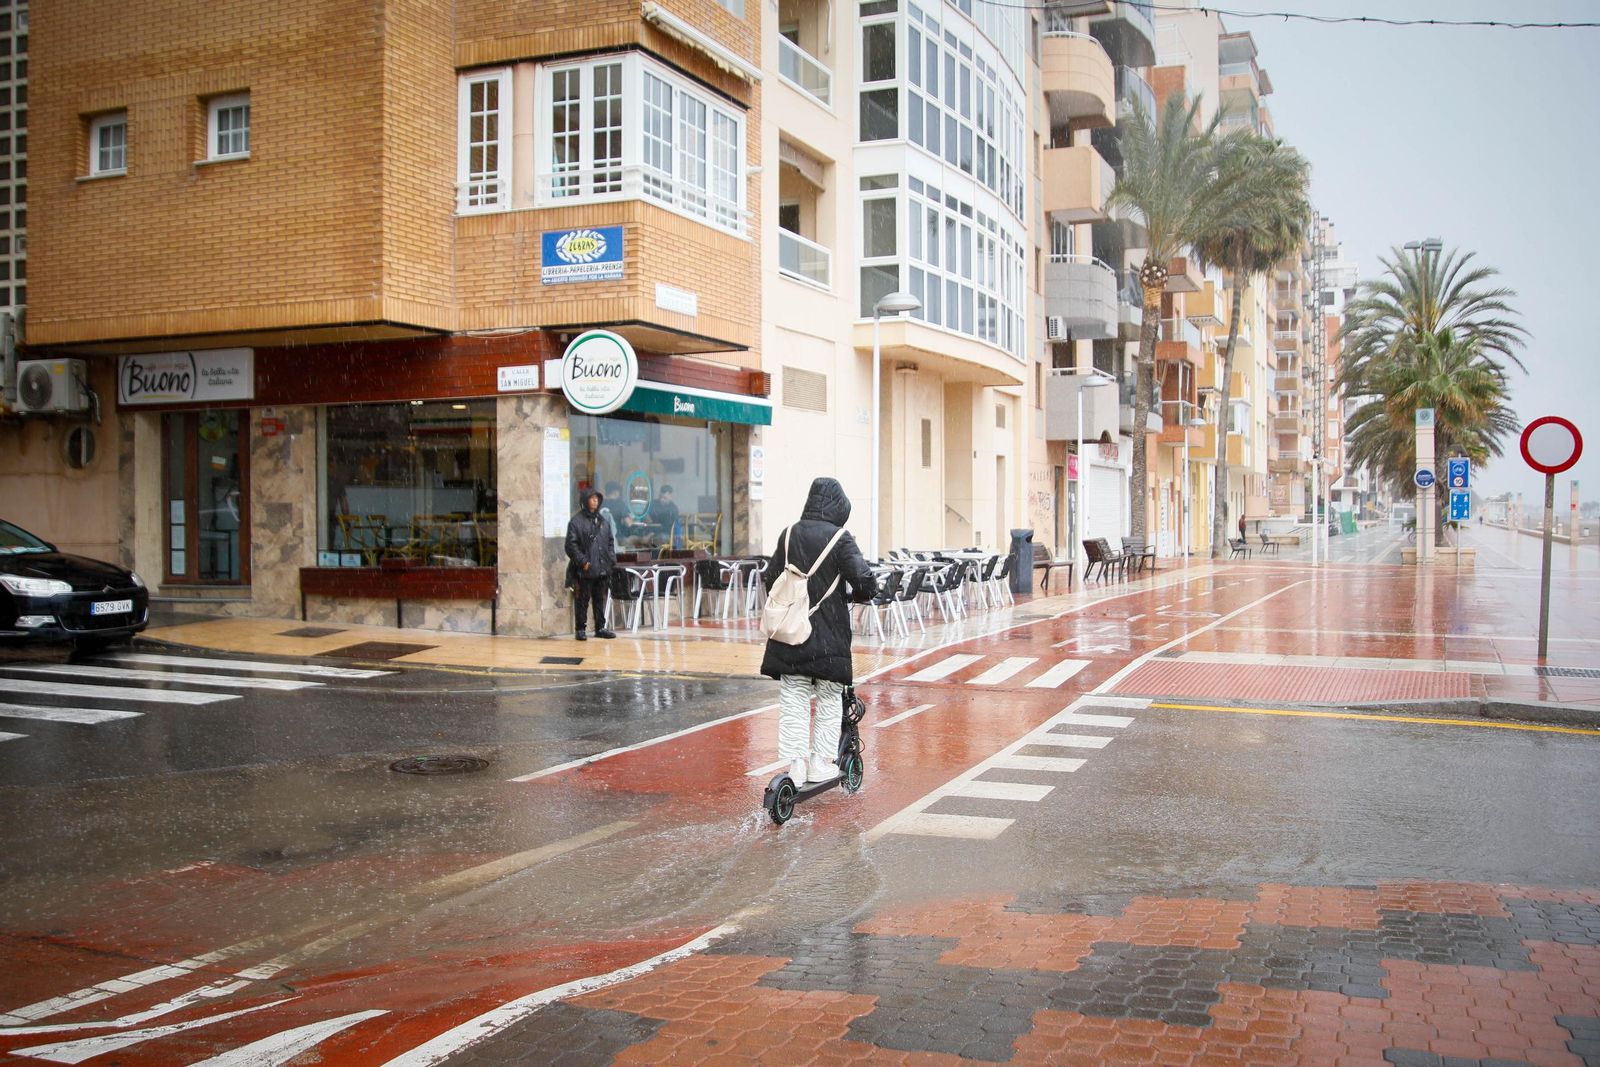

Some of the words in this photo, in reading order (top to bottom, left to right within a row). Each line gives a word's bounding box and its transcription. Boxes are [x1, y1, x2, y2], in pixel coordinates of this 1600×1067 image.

[127, 360, 190, 396] Buono
[572, 353, 622, 380] Buono
[500, 379, 511, 387] SAN
[513, 377, 535, 387] MIGUEL
[674, 395, 695, 414] Buono
